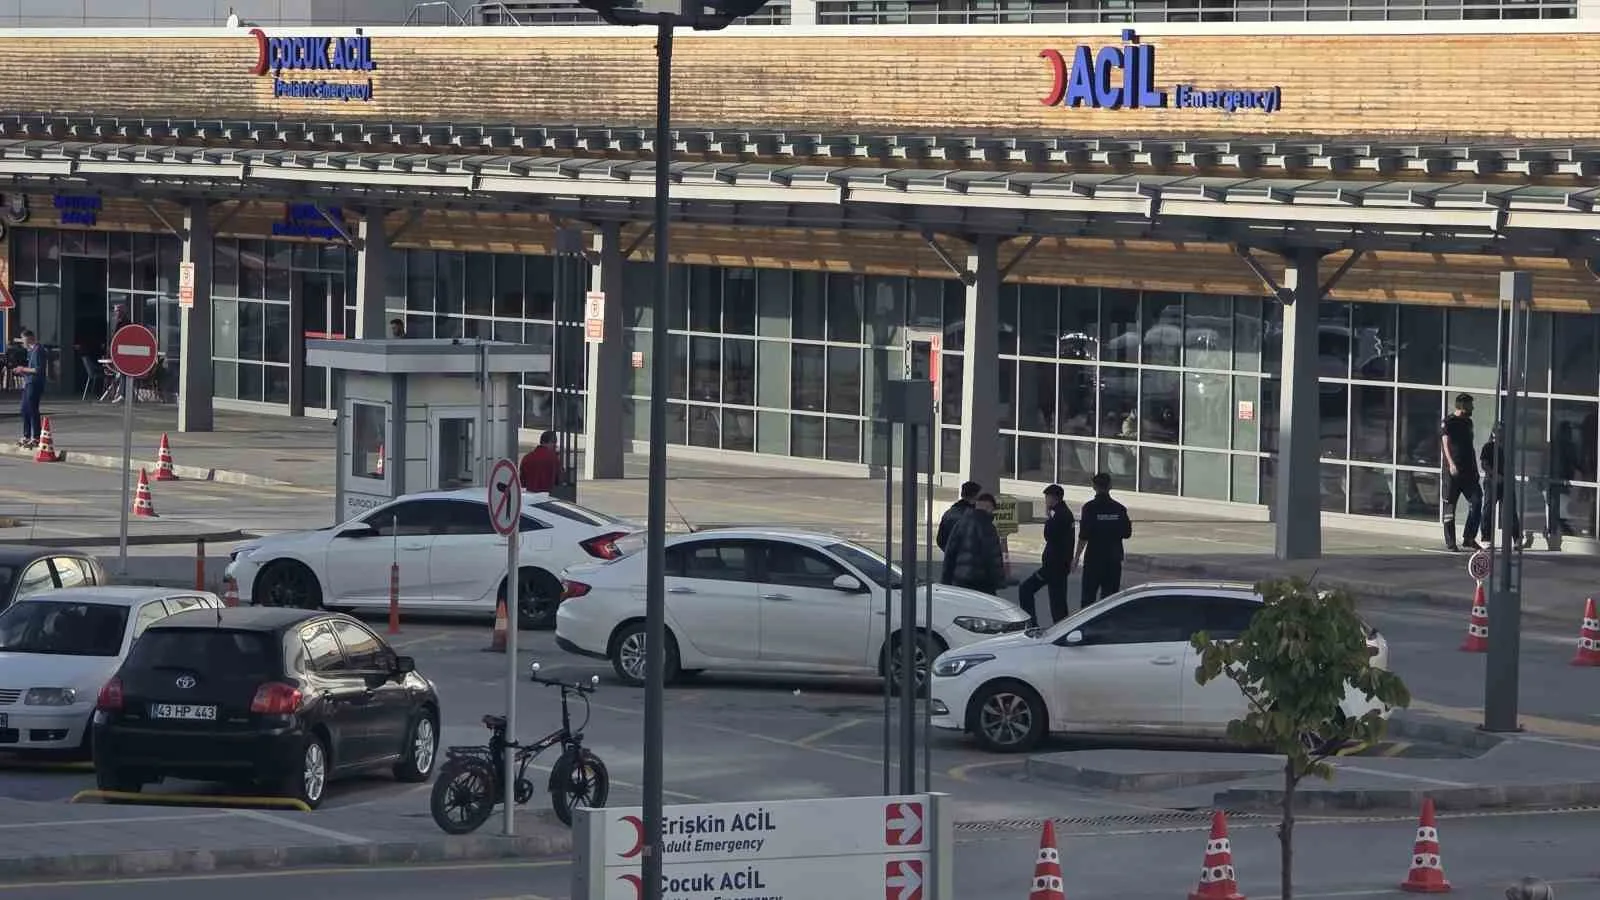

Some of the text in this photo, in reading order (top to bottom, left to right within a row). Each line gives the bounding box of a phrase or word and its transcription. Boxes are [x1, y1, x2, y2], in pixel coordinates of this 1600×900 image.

[269, 28, 376, 77] ÇOCUK ACİL
[1064, 28, 1168, 109] ACİL
[175, 706, 191, 717] HP
[194, 707, 215, 719] 443
[660, 807, 776, 839] Erişkin ACİL
[695, 838, 765, 853] Emergency
[719, 866, 766, 889] ACİL
